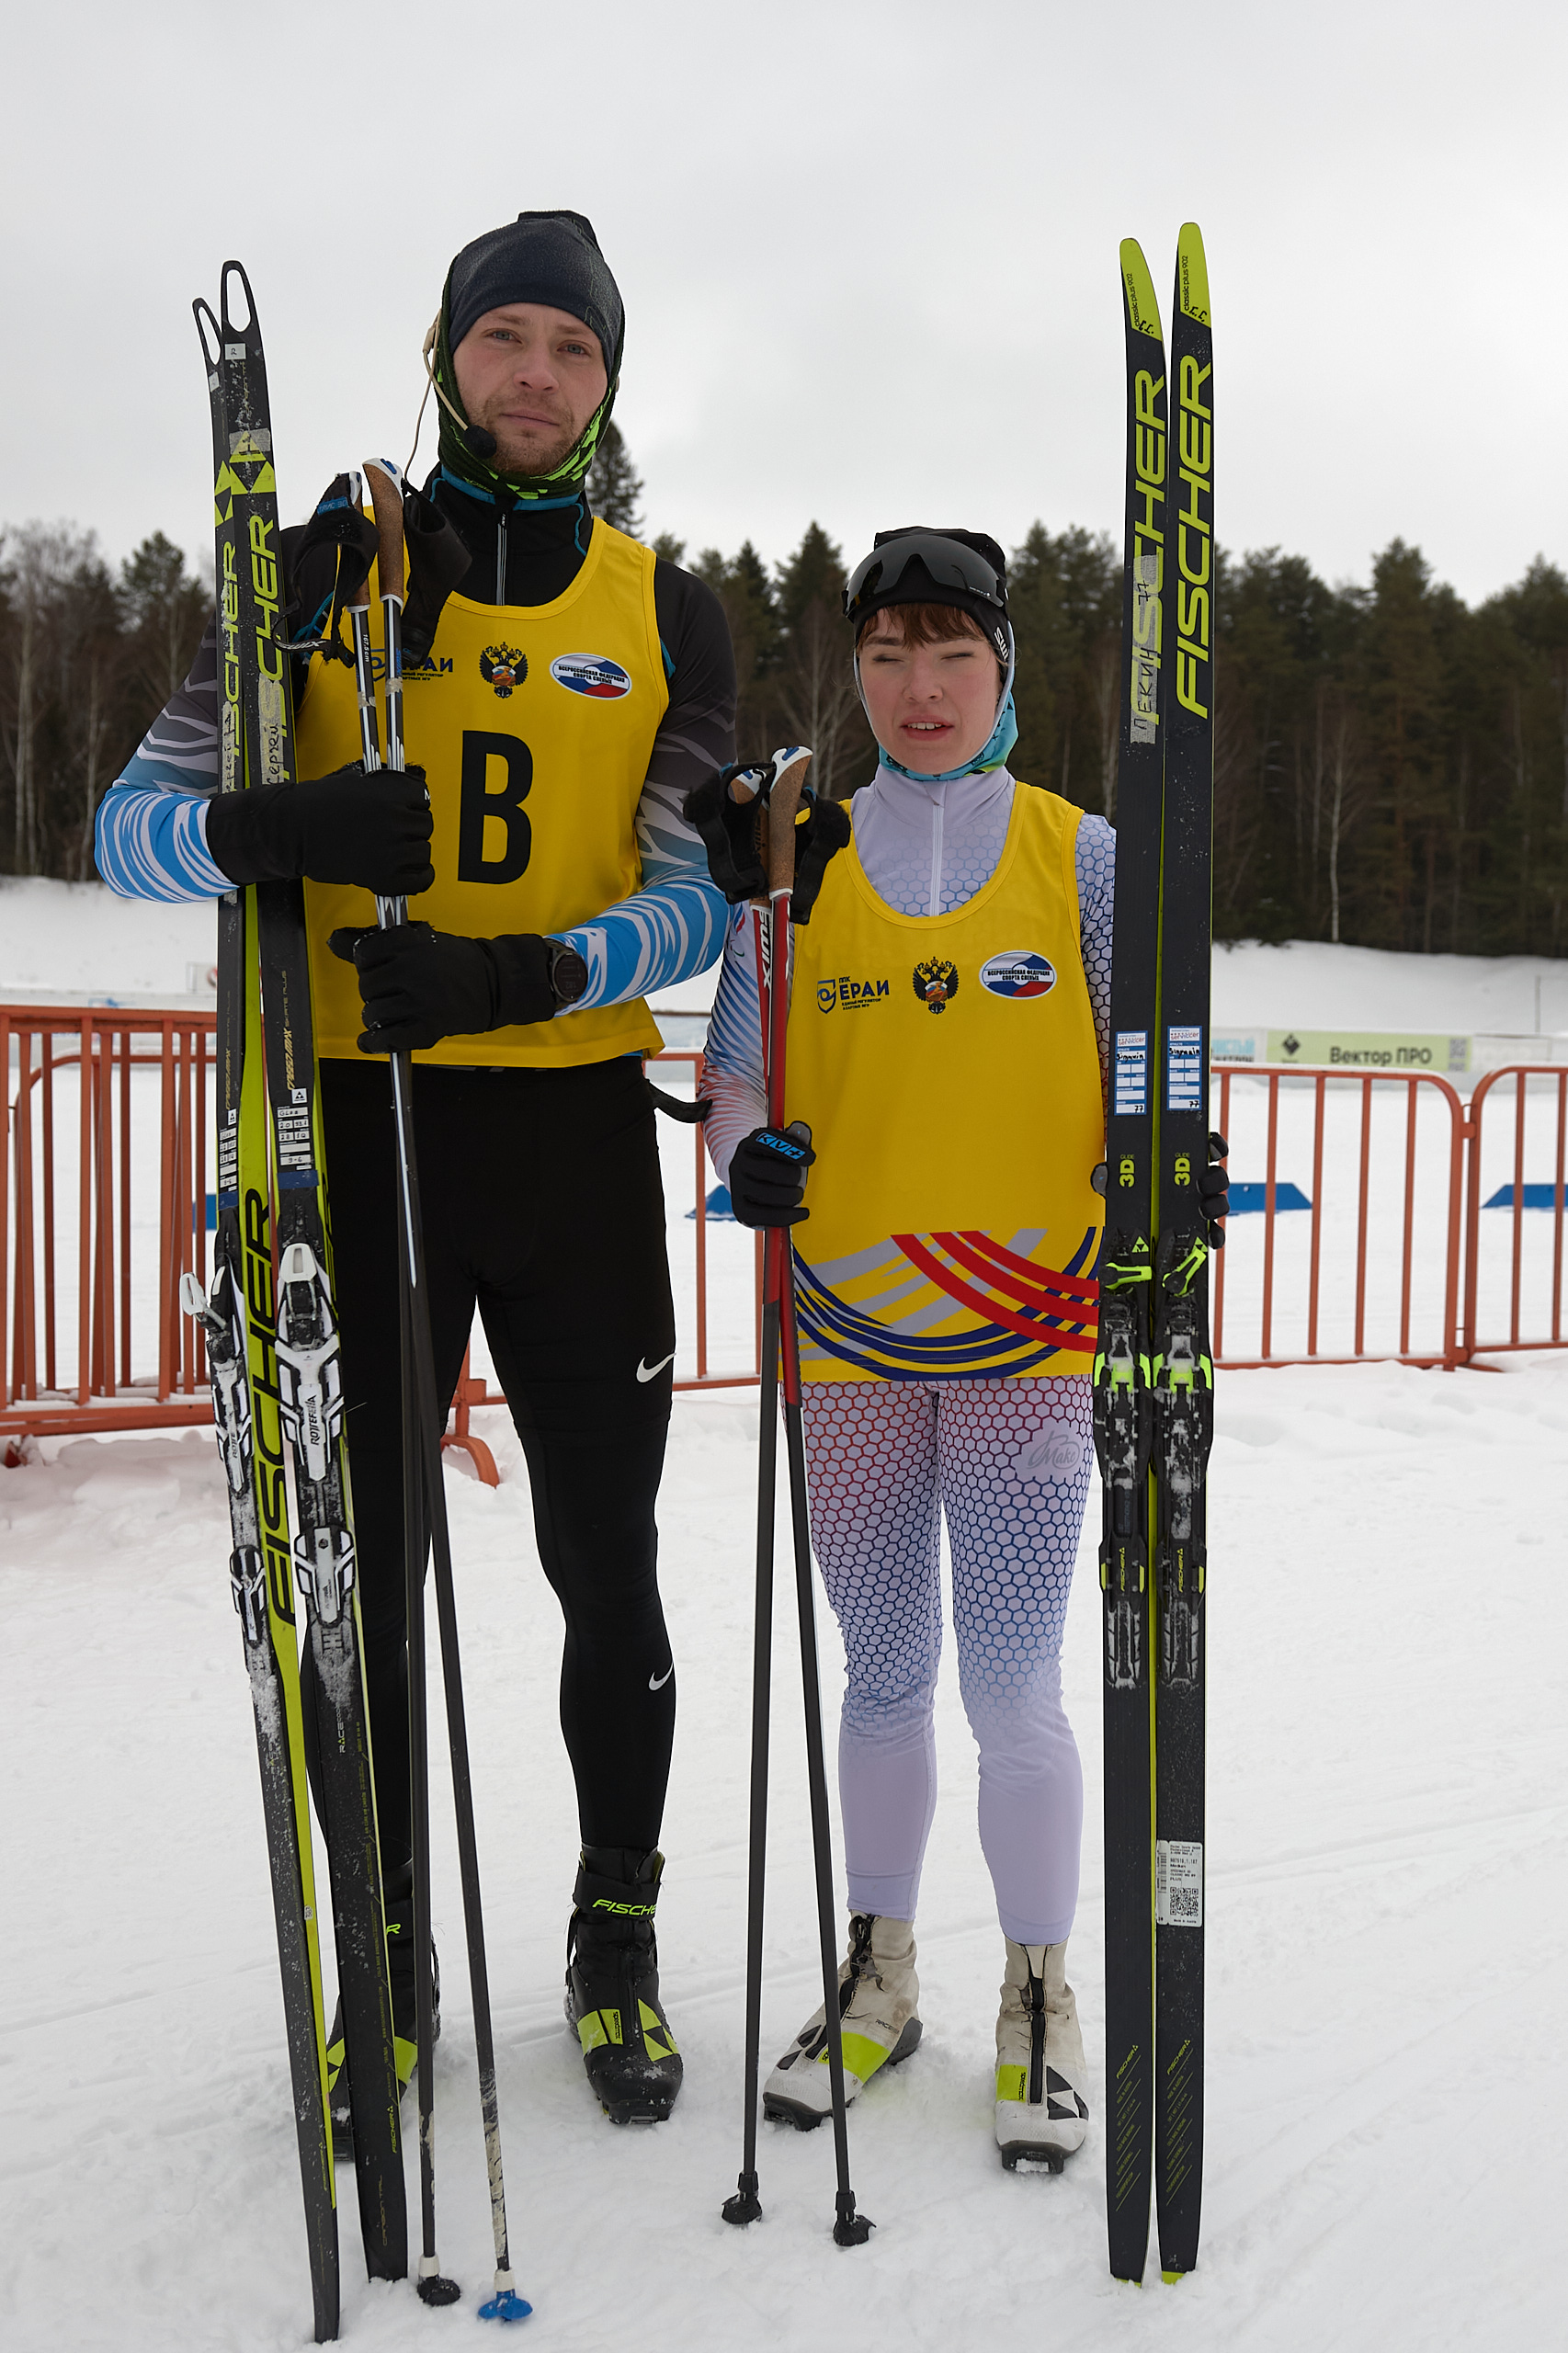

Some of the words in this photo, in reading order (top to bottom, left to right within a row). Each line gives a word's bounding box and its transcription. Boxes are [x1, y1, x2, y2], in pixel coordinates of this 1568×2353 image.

[1130, 286, 1138, 302] plus
[1176, 355, 1211, 719] FISCHER
[1138, 582, 1150, 607] 77
[1133, 649, 1157, 731] ПЕКИН
[264, 723, 283, 784] Сергей
[839, 980, 890, 1000] ЕРАИ
[1329, 1047, 1393, 1066] Вектор
[1396, 1048, 1432, 1064] ПРО
[1119, 1159, 1135, 1188] 3D
[1174, 1157, 1191, 1187] 3D
[245, 1188, 295, 1626] FISCHER
[1117, 2049, 1135, 2079] FISCHER
[1167, 2044, 1187, 2075] FISCHER
[391, 2115, 399, 2154] FISCHER
